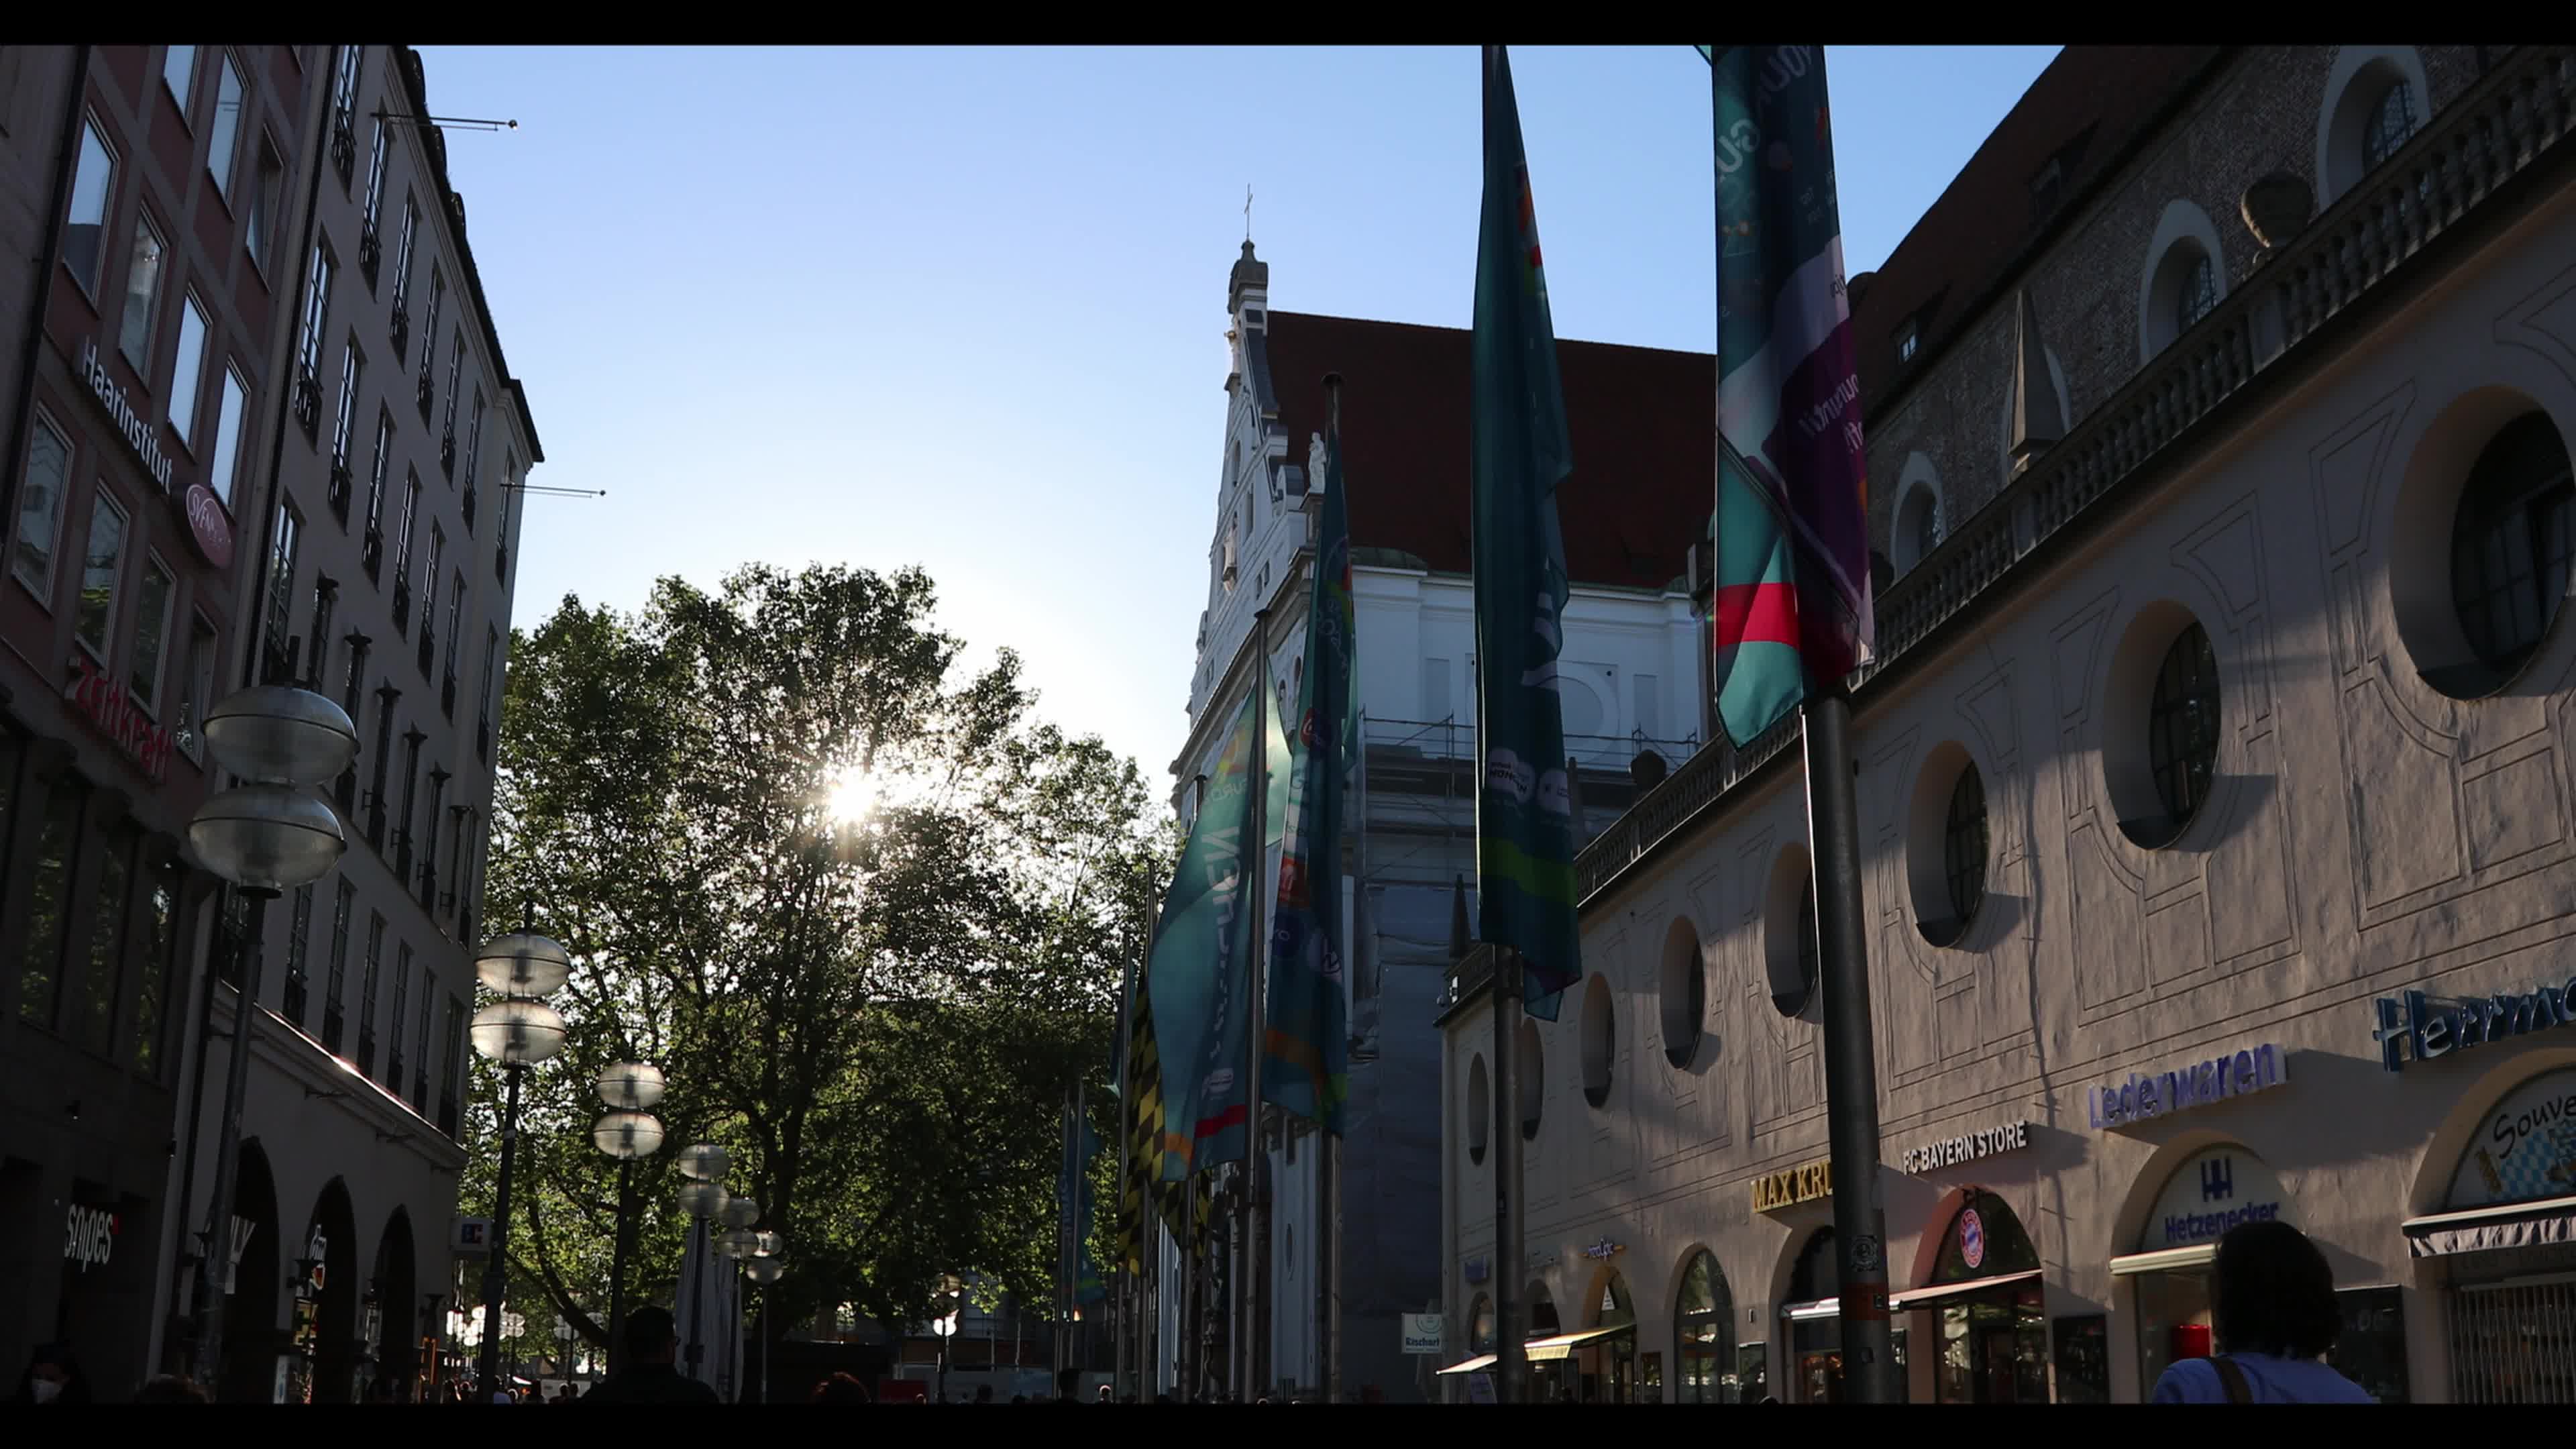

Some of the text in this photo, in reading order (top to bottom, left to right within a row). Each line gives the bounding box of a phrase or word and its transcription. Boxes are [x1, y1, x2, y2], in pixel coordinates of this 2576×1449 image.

[81, 335, 172, 495] Haarinstitut
[2089, 1042, 2277, 1128] Lederwaren
[1903, 1120, 2029, 1175] FC BAYERN STORE
[1750, 1159, 1835, 1213] MAX KRU
[64, 1203, 113, 1272] snipes
[2164, 1201, 2279, 1242] Hetzenecker
